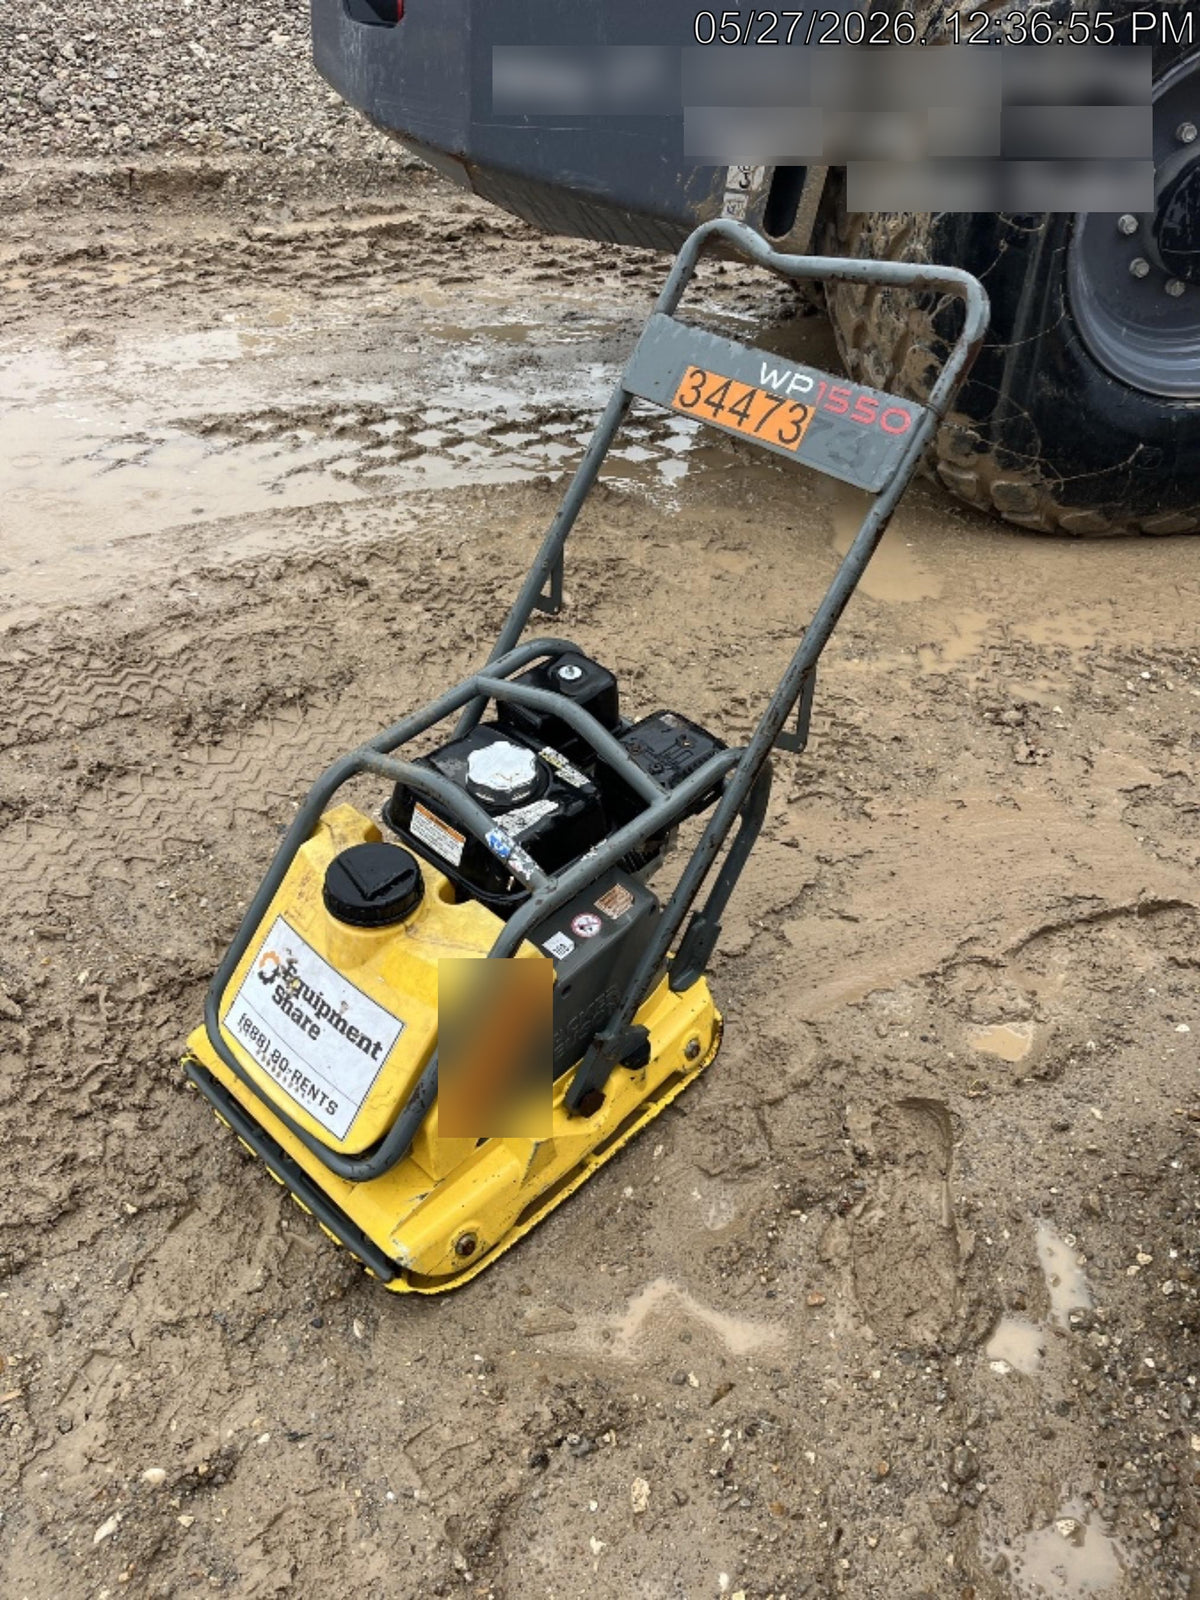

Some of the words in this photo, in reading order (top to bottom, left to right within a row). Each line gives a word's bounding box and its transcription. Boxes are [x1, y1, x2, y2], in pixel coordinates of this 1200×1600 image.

[678, 369, 808, 445] 34473
[759, 361, 912, 435] WP1550
[271, 984, 322, 1041] Share
[281, 959, 384, 1061] Equipment
[237, 1012, 271, 1054] (888)
[270, 1049, 339, 1116] 80-RENTS
